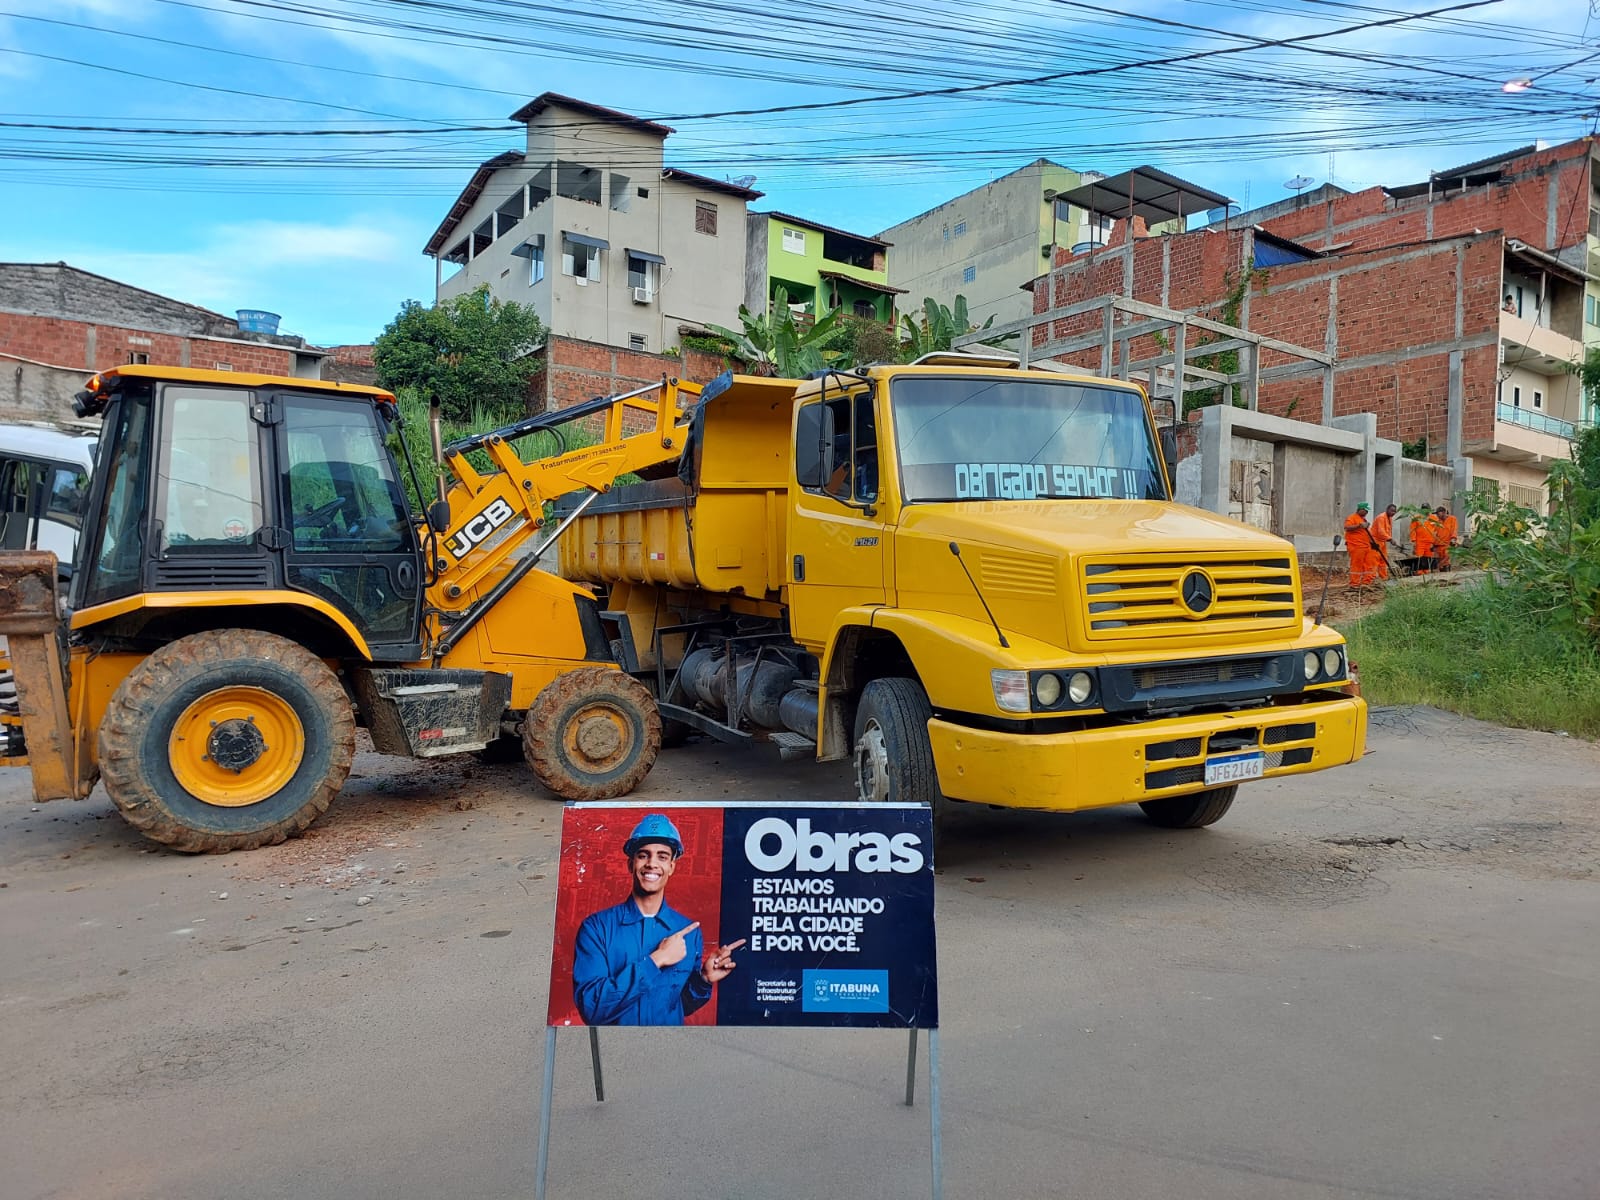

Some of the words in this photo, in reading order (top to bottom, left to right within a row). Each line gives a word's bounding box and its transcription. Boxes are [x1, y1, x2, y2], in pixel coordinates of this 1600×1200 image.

[452, 499, 512, 557] JCB
[744, 817, 924, 874] Obras
[752, 878, 834, 895] ESTAMOS
[752, 897, 885, 915] TRABALHANDO
[752, 916, 794, 933] PELA
[798, 916, 864, 933] CIDADE
[751, 935, 762, 951] E
[766, 935, 802, 952] POR
[808, 932, 860, 952] VOCÊ.
[757, 979, 786, 987] Secretaria
[787, 979, 796, 987] de
[830, 983, 880, 993] ITABUNA
